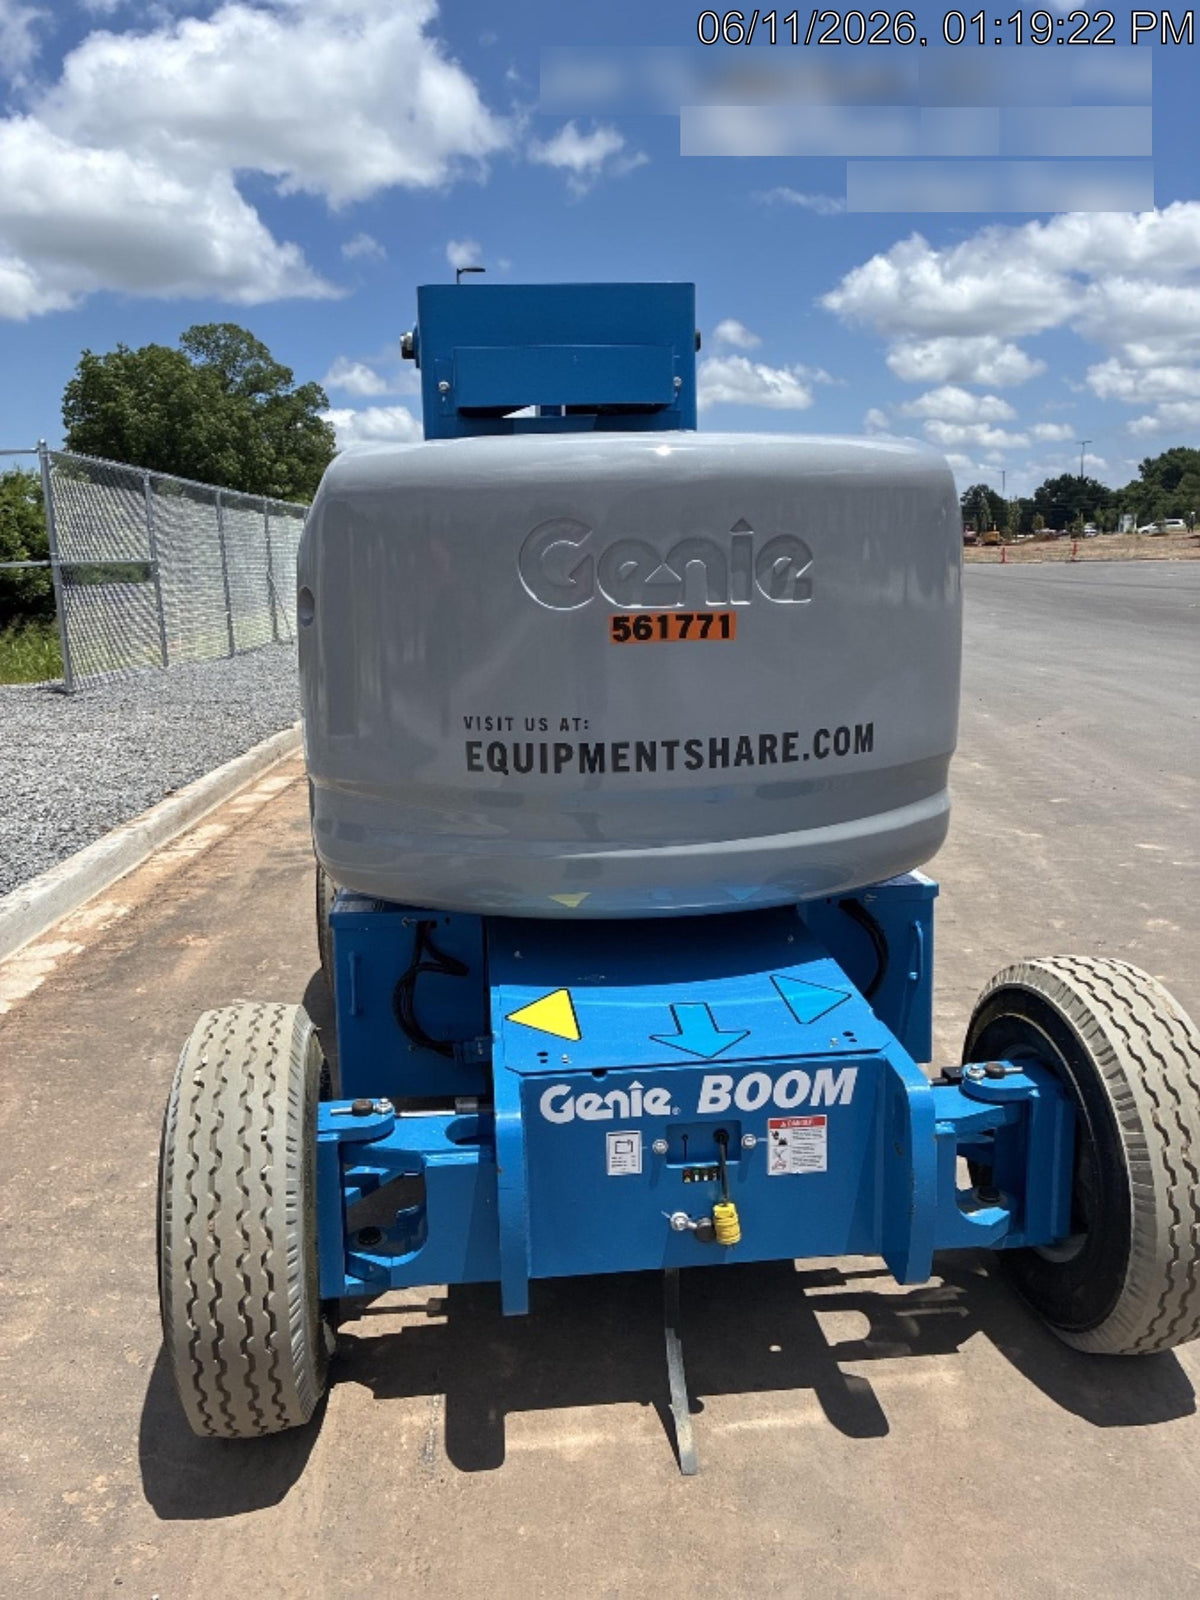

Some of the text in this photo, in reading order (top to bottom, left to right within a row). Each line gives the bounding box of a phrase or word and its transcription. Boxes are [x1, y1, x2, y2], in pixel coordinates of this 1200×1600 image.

[518, 517, 814, 611] Genie
[612, 614, 731, 643] 561771
[463, 716, 590, 732] VISIT US AT:
[465, 722, 875, 776] EQUIPMENTSHARE.COM
[539, 1067, 859, 1124] Genie BOOM
